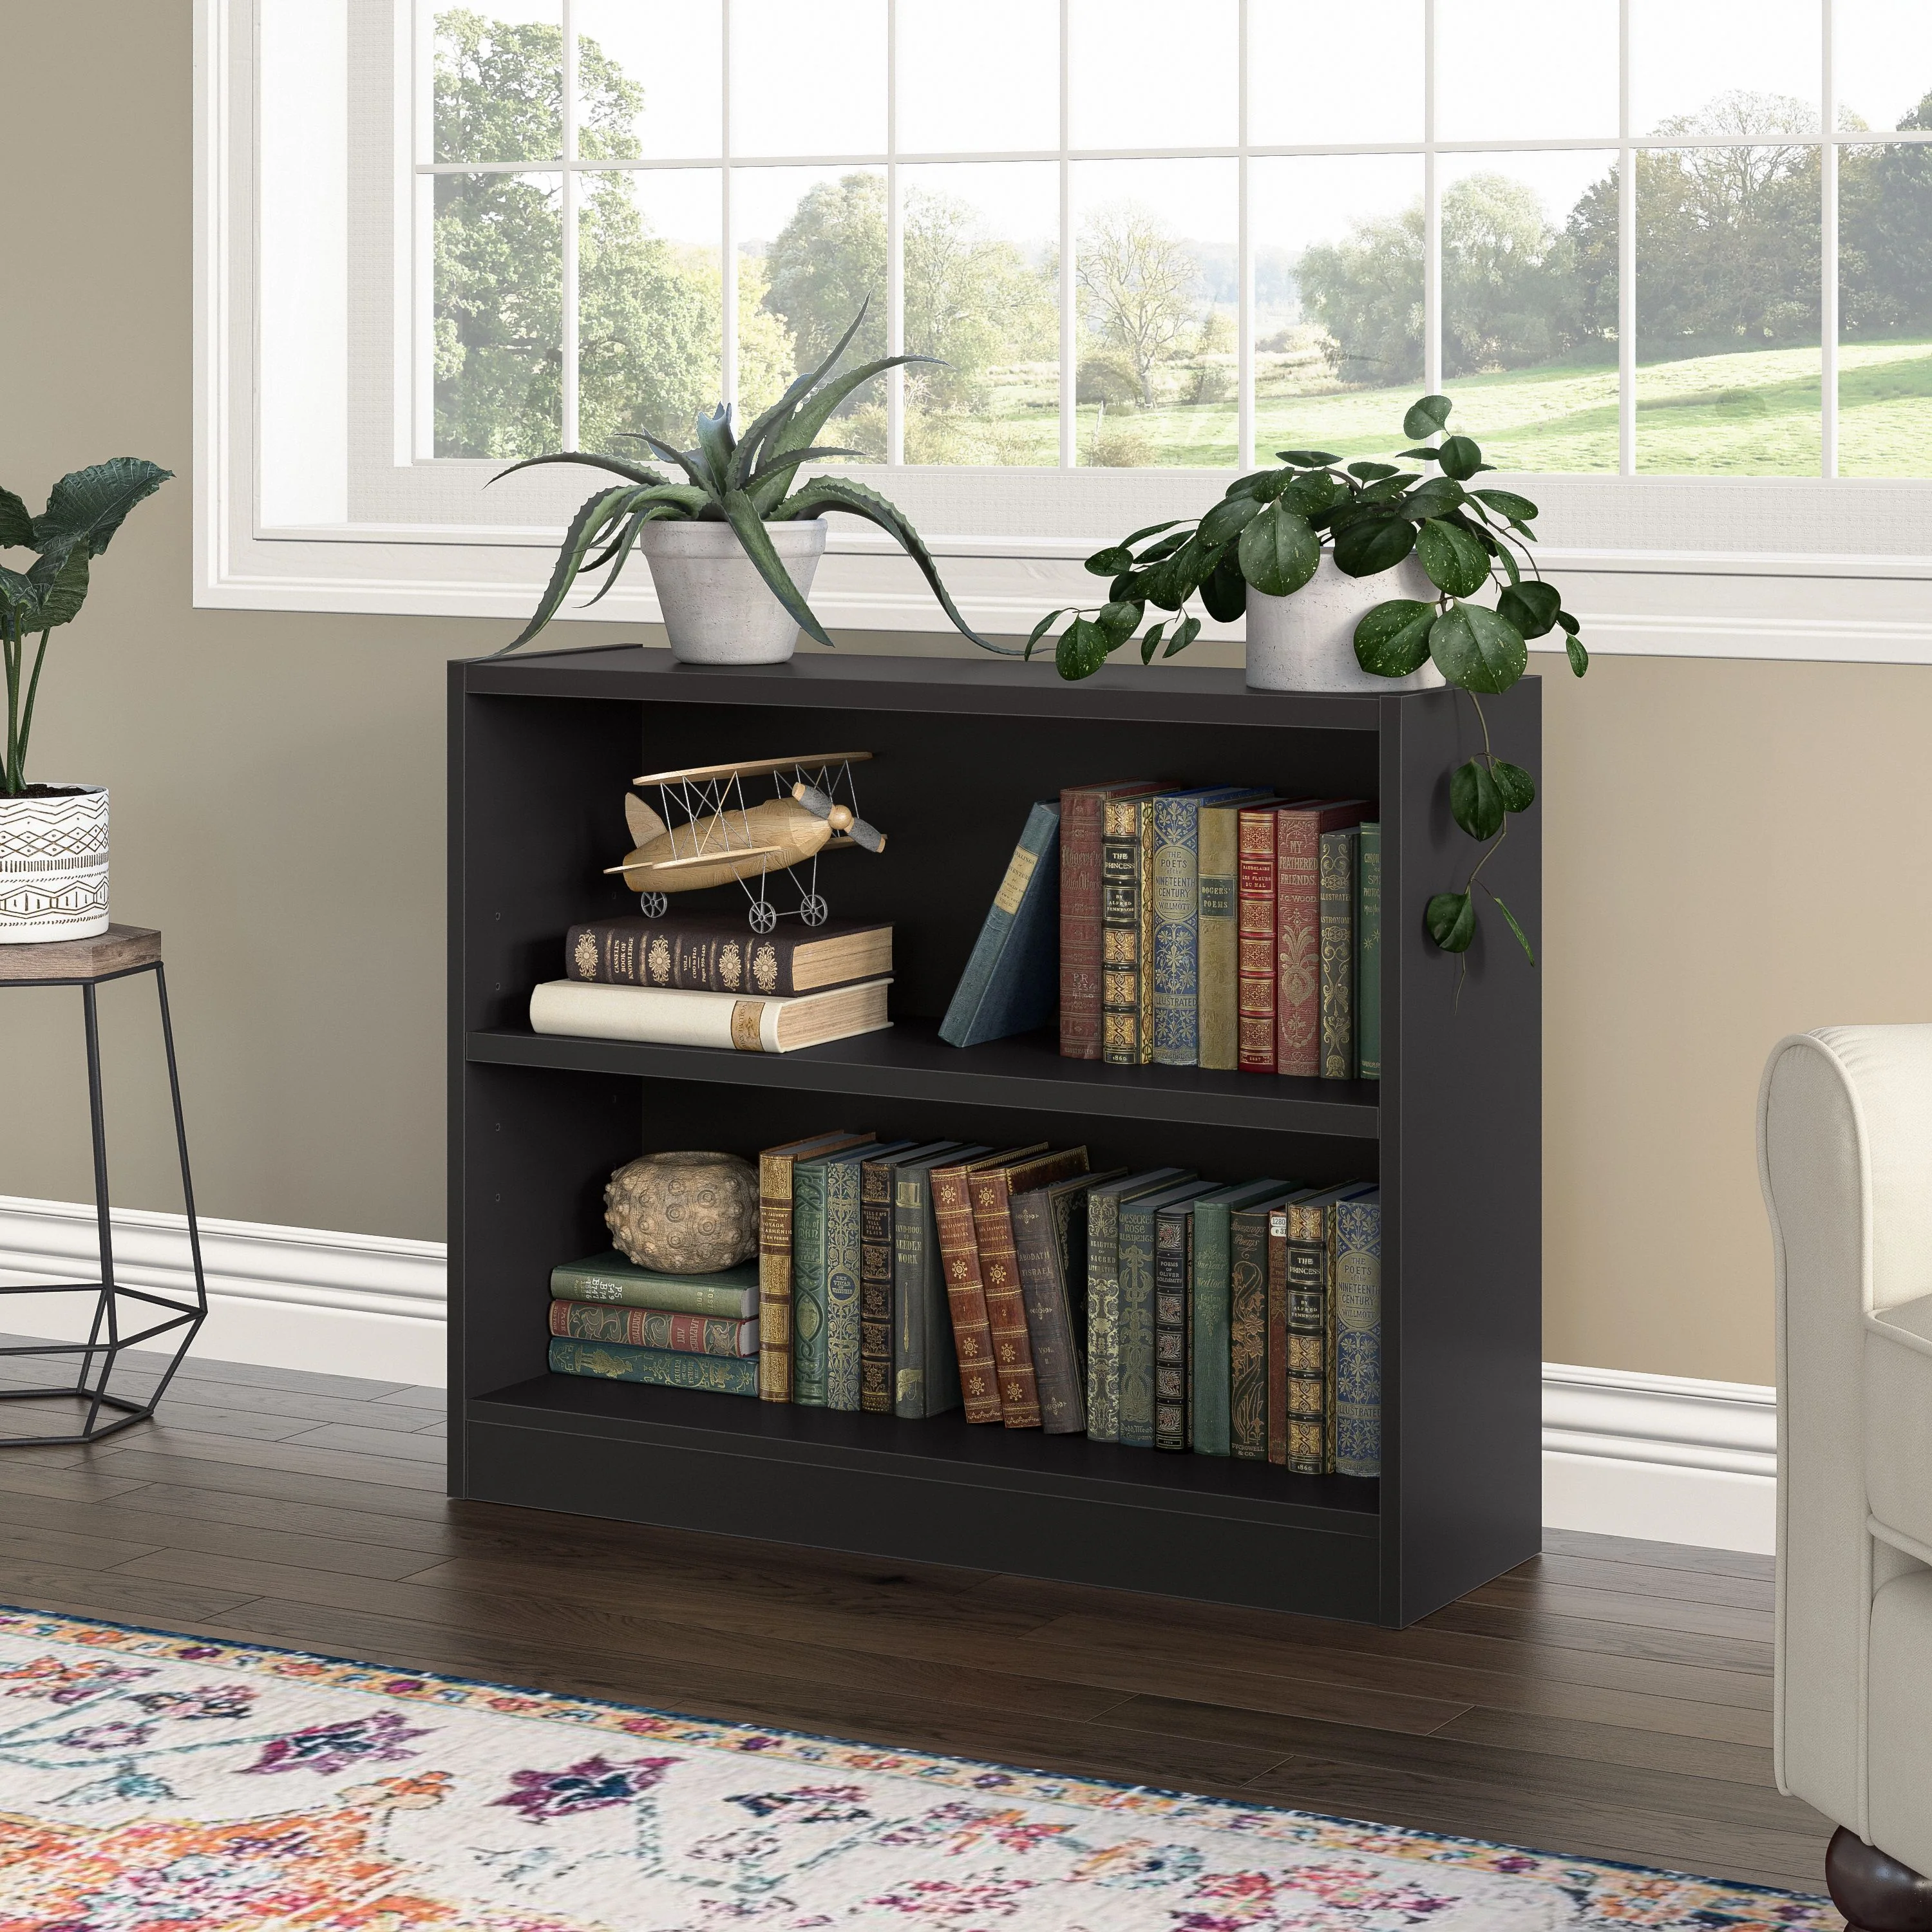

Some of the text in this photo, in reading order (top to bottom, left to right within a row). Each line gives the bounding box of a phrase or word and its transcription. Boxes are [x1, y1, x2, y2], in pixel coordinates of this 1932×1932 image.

[1290, 840, 1303, 854] MY
[1160, 858, 1187, 868] POETS
[1280, 856, 1318, 870] FEATHERED
[1155, 876, 1195, 887] NINETEENTH
[1159, 887, 1191, 898] CENTURY
[1202, 886, 1231, 895] ROGERS'
[1159, 902, 1191, 911] WILLMOTT
[621, 942, 627, 952] OF
[1154, 996, 1197, 1007] ILLUSTRATED
[896, 1239, 922, 1251] NEEDLE
[1090, 1240, 1117, 1249] BEAUTIES
[898, 1253, 918, 1264] WORK
[1090, 1255, 1116, 1264] SACRED
[1290, 1266, 1320, 1274] PRINCESS
[1344, 1265, 1372, 1275] POETS
[600, 1281, 608, 1300] B74
[614, 1286, 623, 1299] PS
[1339, 1282, 1381, 1295] NINETEENTH
[1342, 1294, 1376, 1305] CENTURY
[1341, 1309, 1376, 1319] WILLMOTT
[677, 1327, 685, 1344] ART
